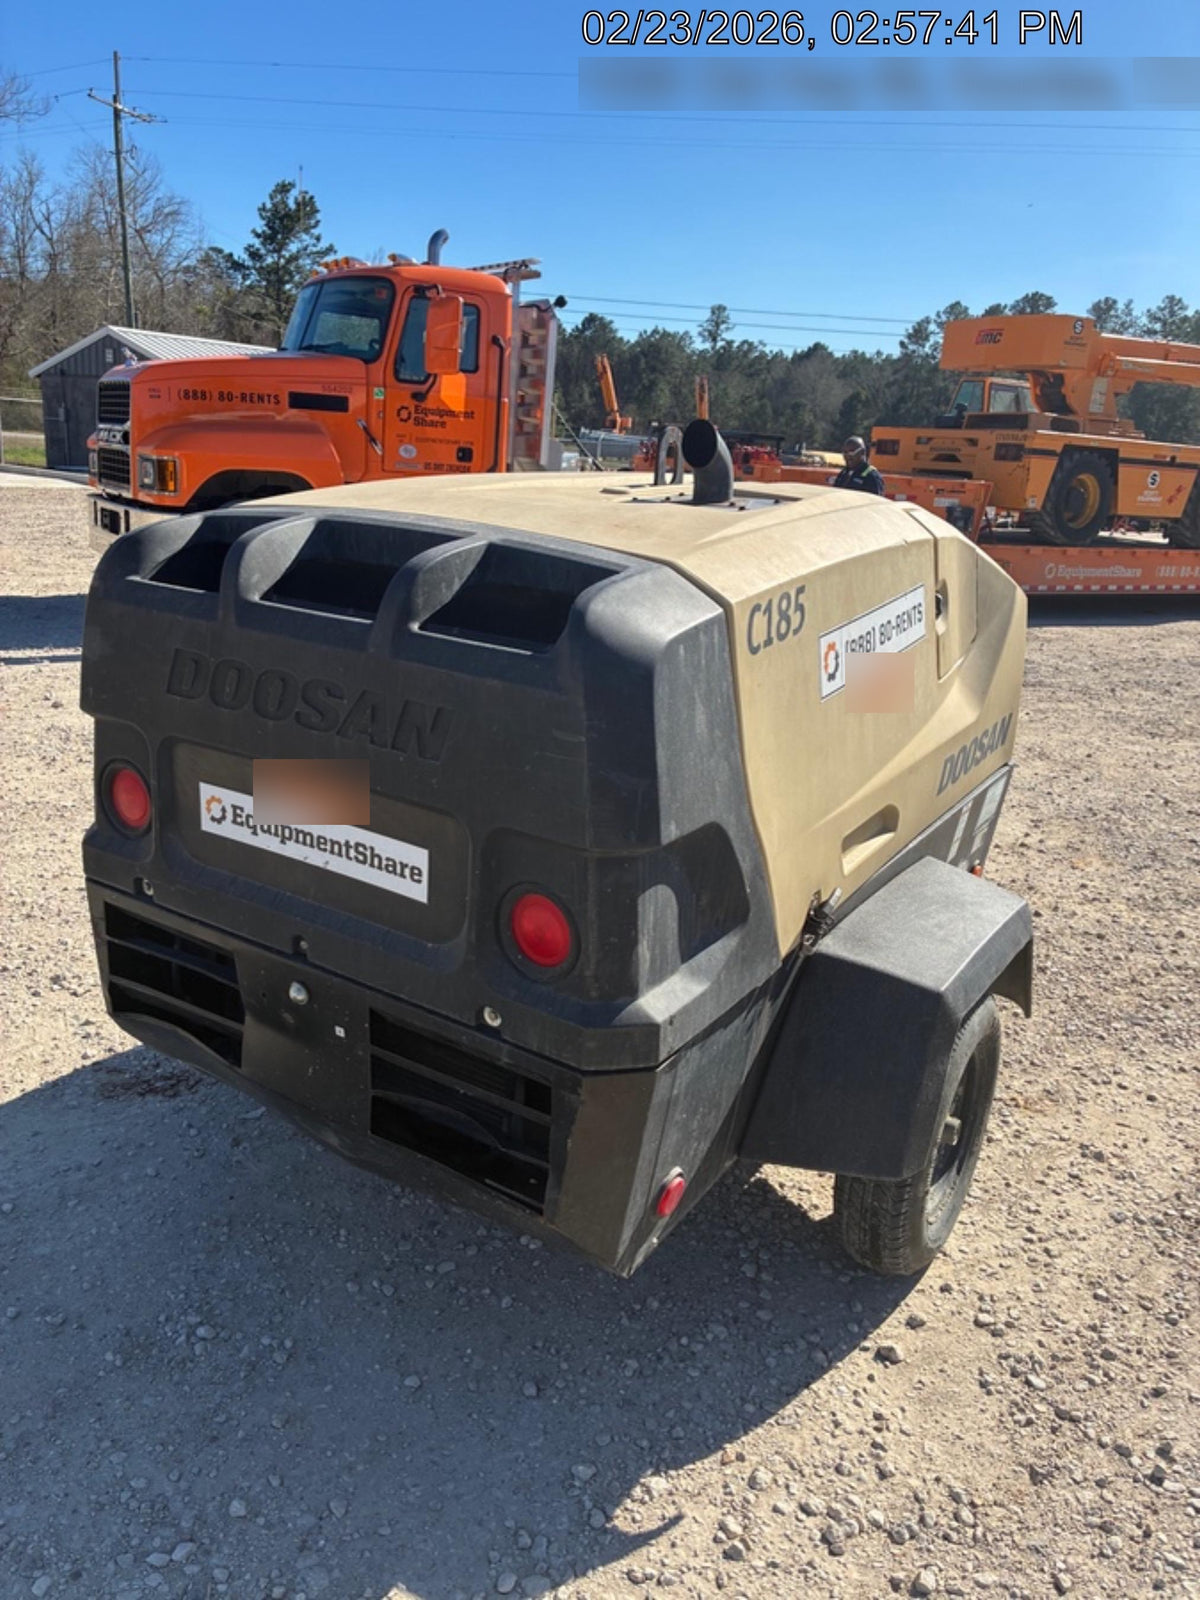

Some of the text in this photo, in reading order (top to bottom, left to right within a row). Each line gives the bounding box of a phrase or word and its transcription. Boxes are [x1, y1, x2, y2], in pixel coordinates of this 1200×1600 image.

[177, 388, 213, 402] (888)
[217, 390, 281, 406] 80-RENTS
[413, 404, 475, 420] Equipmnt
[413, 416, 447, 429] Share
[747, 584, 806, 656] C185
[879, 602, 923, 646] 80-RENTS
[166, 648, 451, 763] DOOSAN
[936, 713, 1013, 796] DOOSAN
